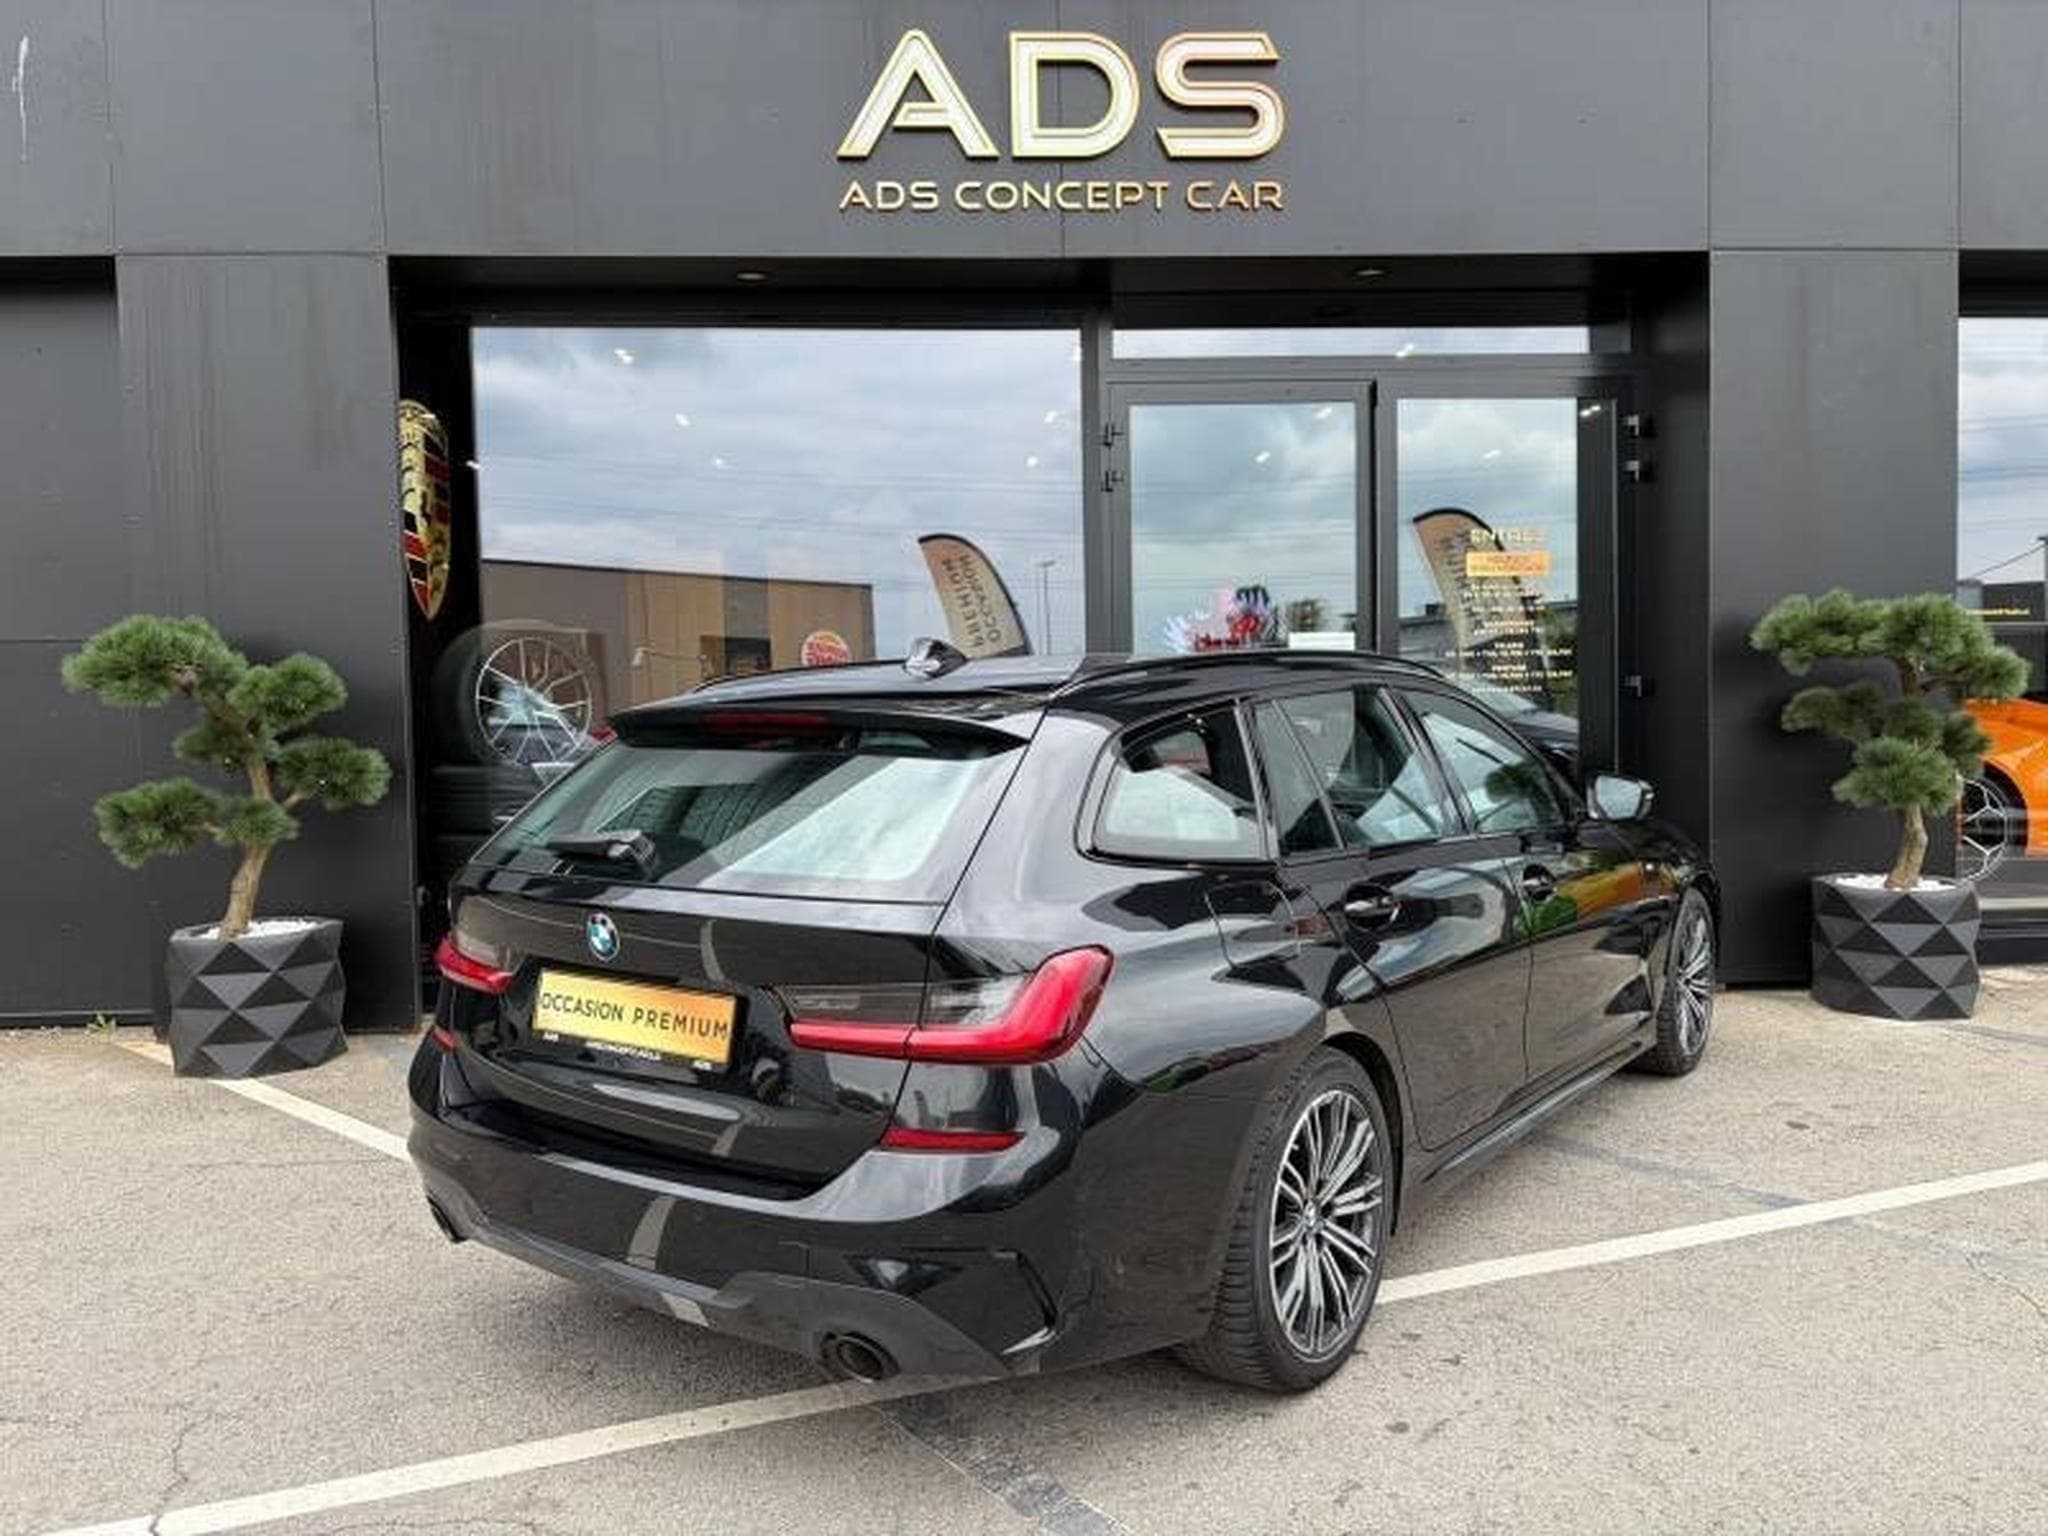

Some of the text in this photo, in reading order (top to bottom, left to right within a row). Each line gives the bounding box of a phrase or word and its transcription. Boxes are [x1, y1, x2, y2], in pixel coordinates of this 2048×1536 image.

[836, 29, 1285, 160] ADS
[839, 181, 1285, 211] ADS CONCEPT CAR
[541, 992, 729, 1039] OCCASION PREMIUM
